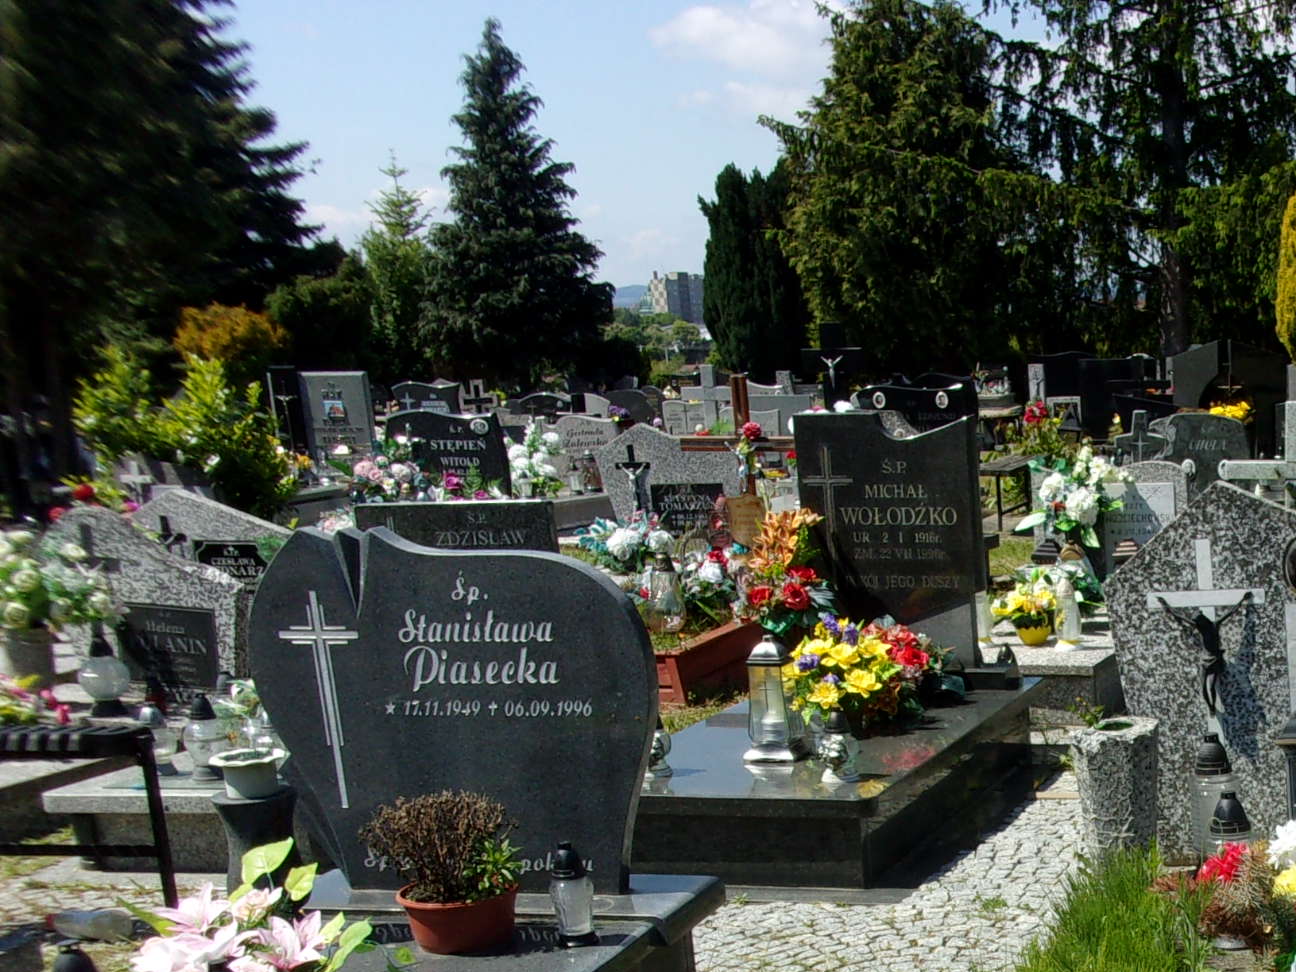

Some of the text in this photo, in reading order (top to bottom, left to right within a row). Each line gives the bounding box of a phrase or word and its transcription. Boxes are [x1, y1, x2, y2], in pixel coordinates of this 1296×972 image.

[864, 484, 928, 499] MICHAŁ
[840, 502, 958, 526] WOŁODŹKO
[146, 621, 185, 634] Helena
[398, 608, 554, 643] Stanisława
[403, 645, 561, 692] Piasecka
[404, 699, 593, 717] 17.11.1949 06.09.1996
